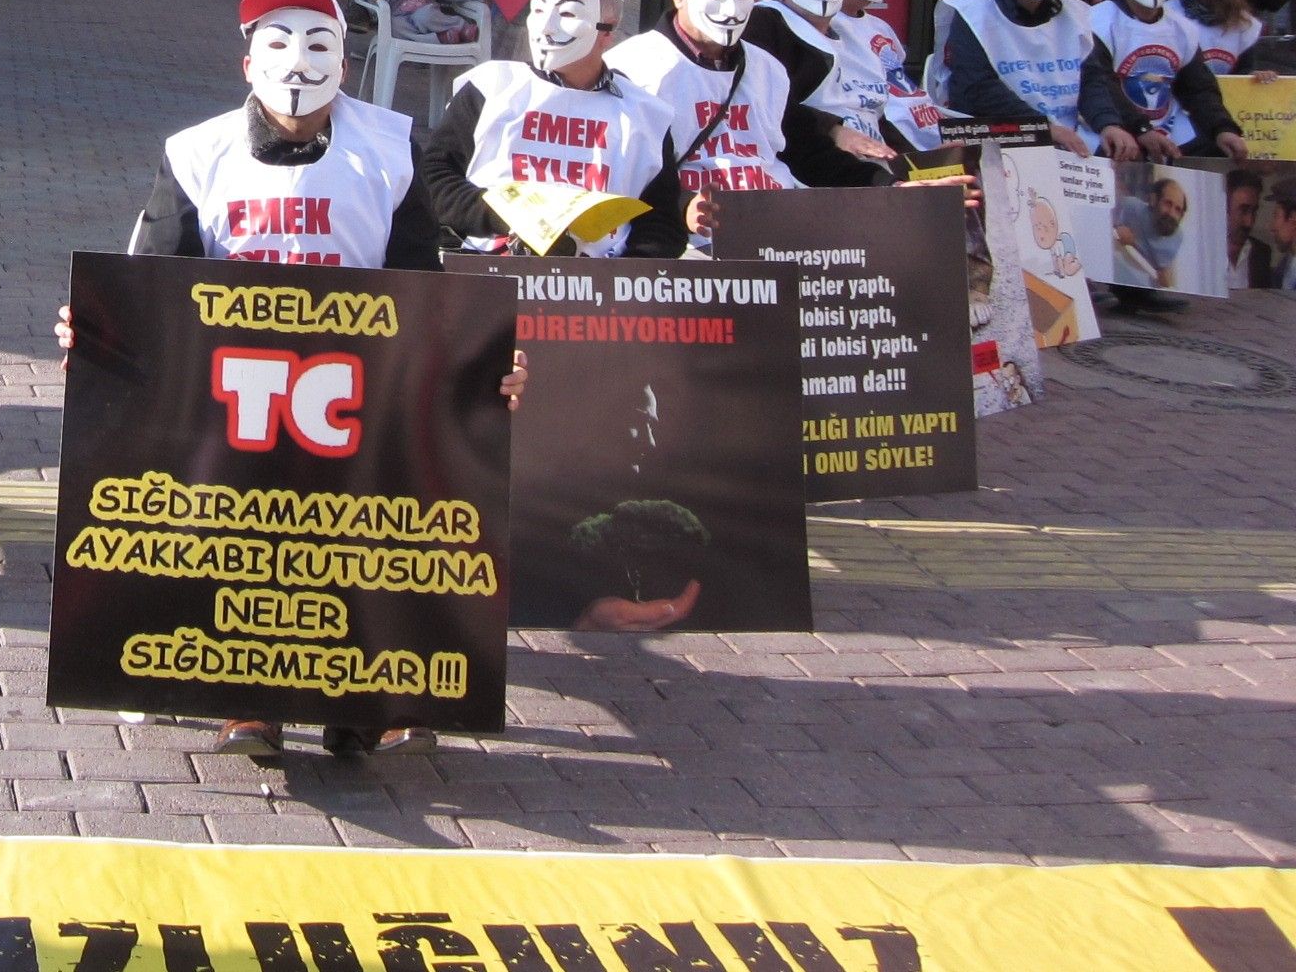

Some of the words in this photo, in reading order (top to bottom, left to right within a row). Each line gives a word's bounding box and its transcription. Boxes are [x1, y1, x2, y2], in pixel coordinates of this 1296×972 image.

[521, 110, 609, 150] EMEK
[1060, 175, 1084, 187] unlar
[227, 196, 334, 239] EMEK
[489, 266, 603, 307] RKÜM,
[613, 269, 778, 305] DOĞRUYUM
[799, 275, 844, 301] üçler
[848, 275, 895, 300] yaptı,
[196, 287, 395, 333] TABELAYA
[516, 308, 735, 344] DİRENİYORUM!
[799, 306, 845, 328] lobisi
[849, 305, 896, 330] yaptı,
[821, 335, 867, 357] lobisi
[862, 367, 907, 393] da!!!
[218, 354, 359, 452] TC
[855, 410, 894, 439] KİM
[900, 411, 958, 435] YAPTI
[815, 450, 859, 475] ONU
[864, 442, 934, 471] SÖYLE!
[93, 476, 476, 540] SIĞDIRAMAYANLAR
[70, 533, 269, 577] AYAKKABI
[281, 546, 494, 593] KUTUSUNA
[219, 593, 344, 633] NELER
[125, 633, 421, 690] SIĞDIRMIŞLAR
